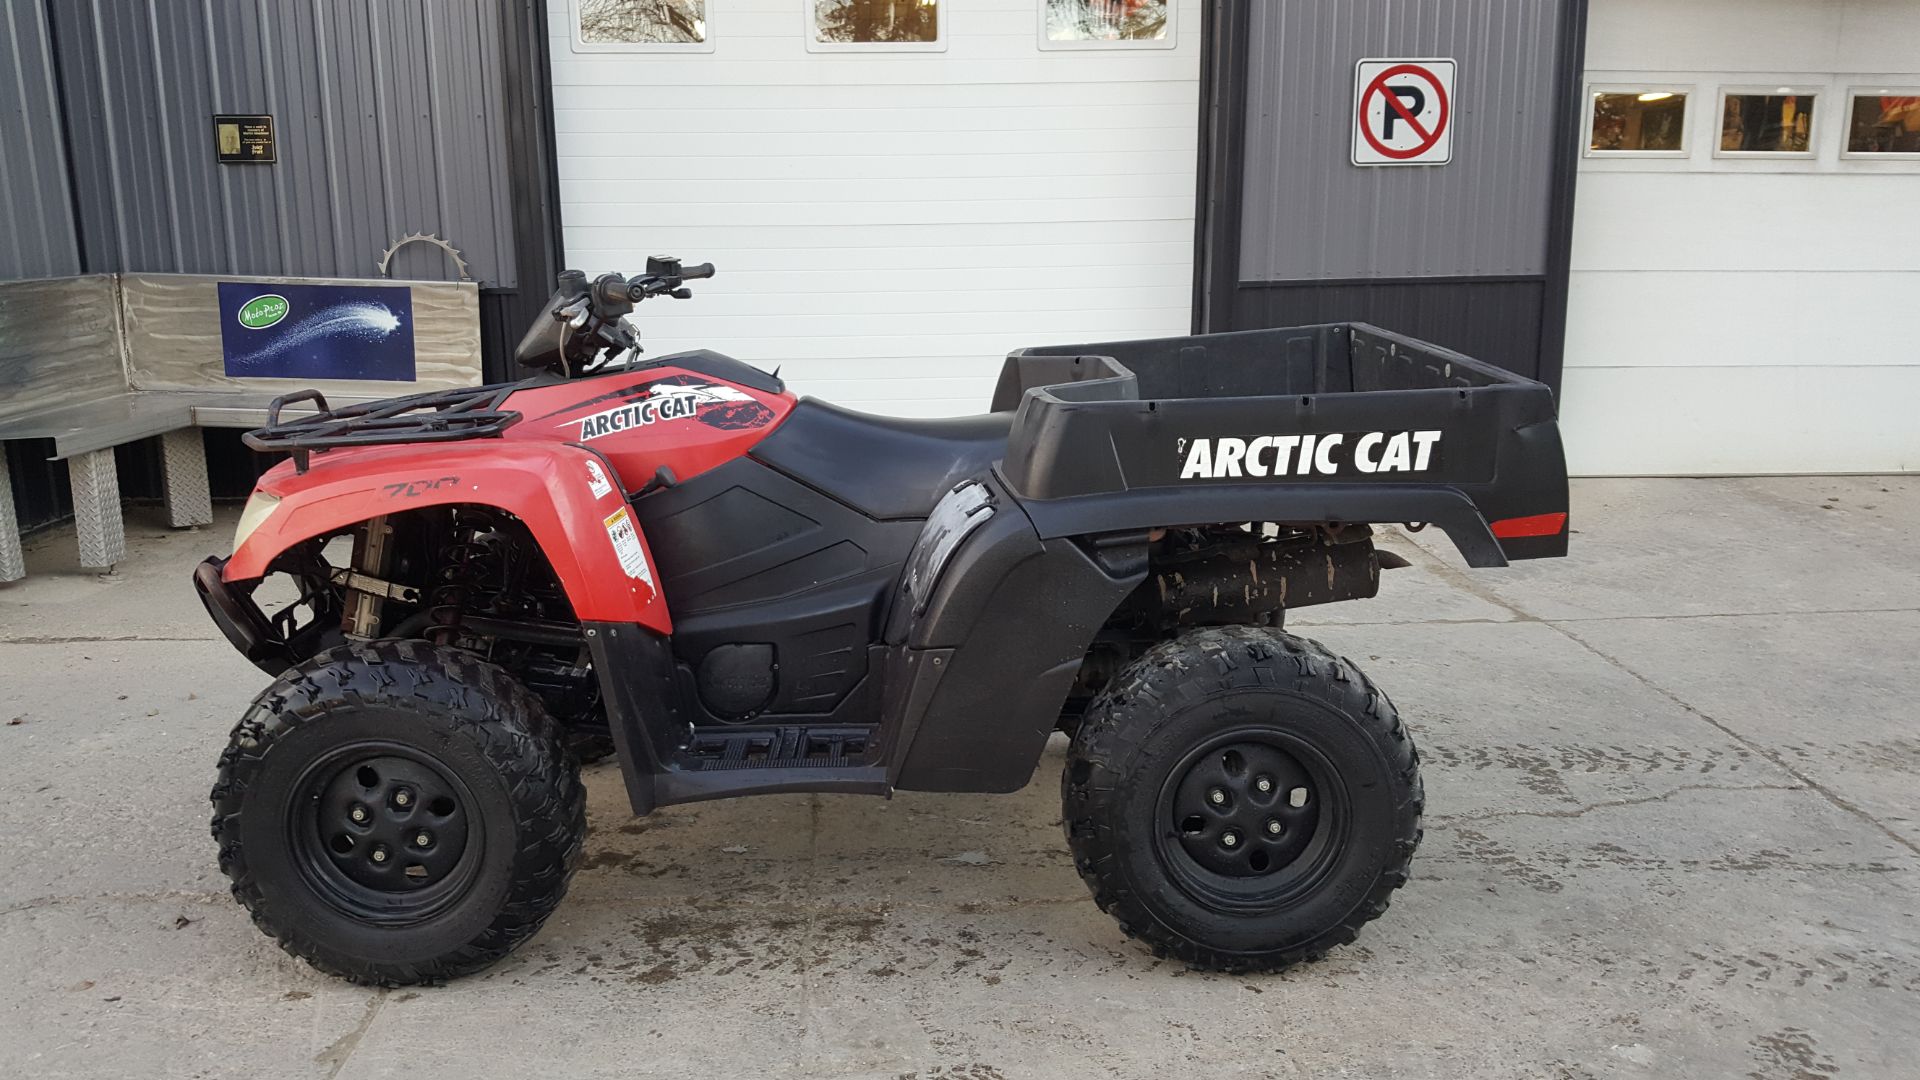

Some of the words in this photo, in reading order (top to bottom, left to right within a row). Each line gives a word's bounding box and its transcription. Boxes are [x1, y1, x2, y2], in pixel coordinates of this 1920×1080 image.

[581, 402, 655, 440] ARCTIC
[659, 395, 697, 418] CAT
[1180, 434, 1343, 479] ARCTIC
[1354, 430, 1441, 473] CAT
